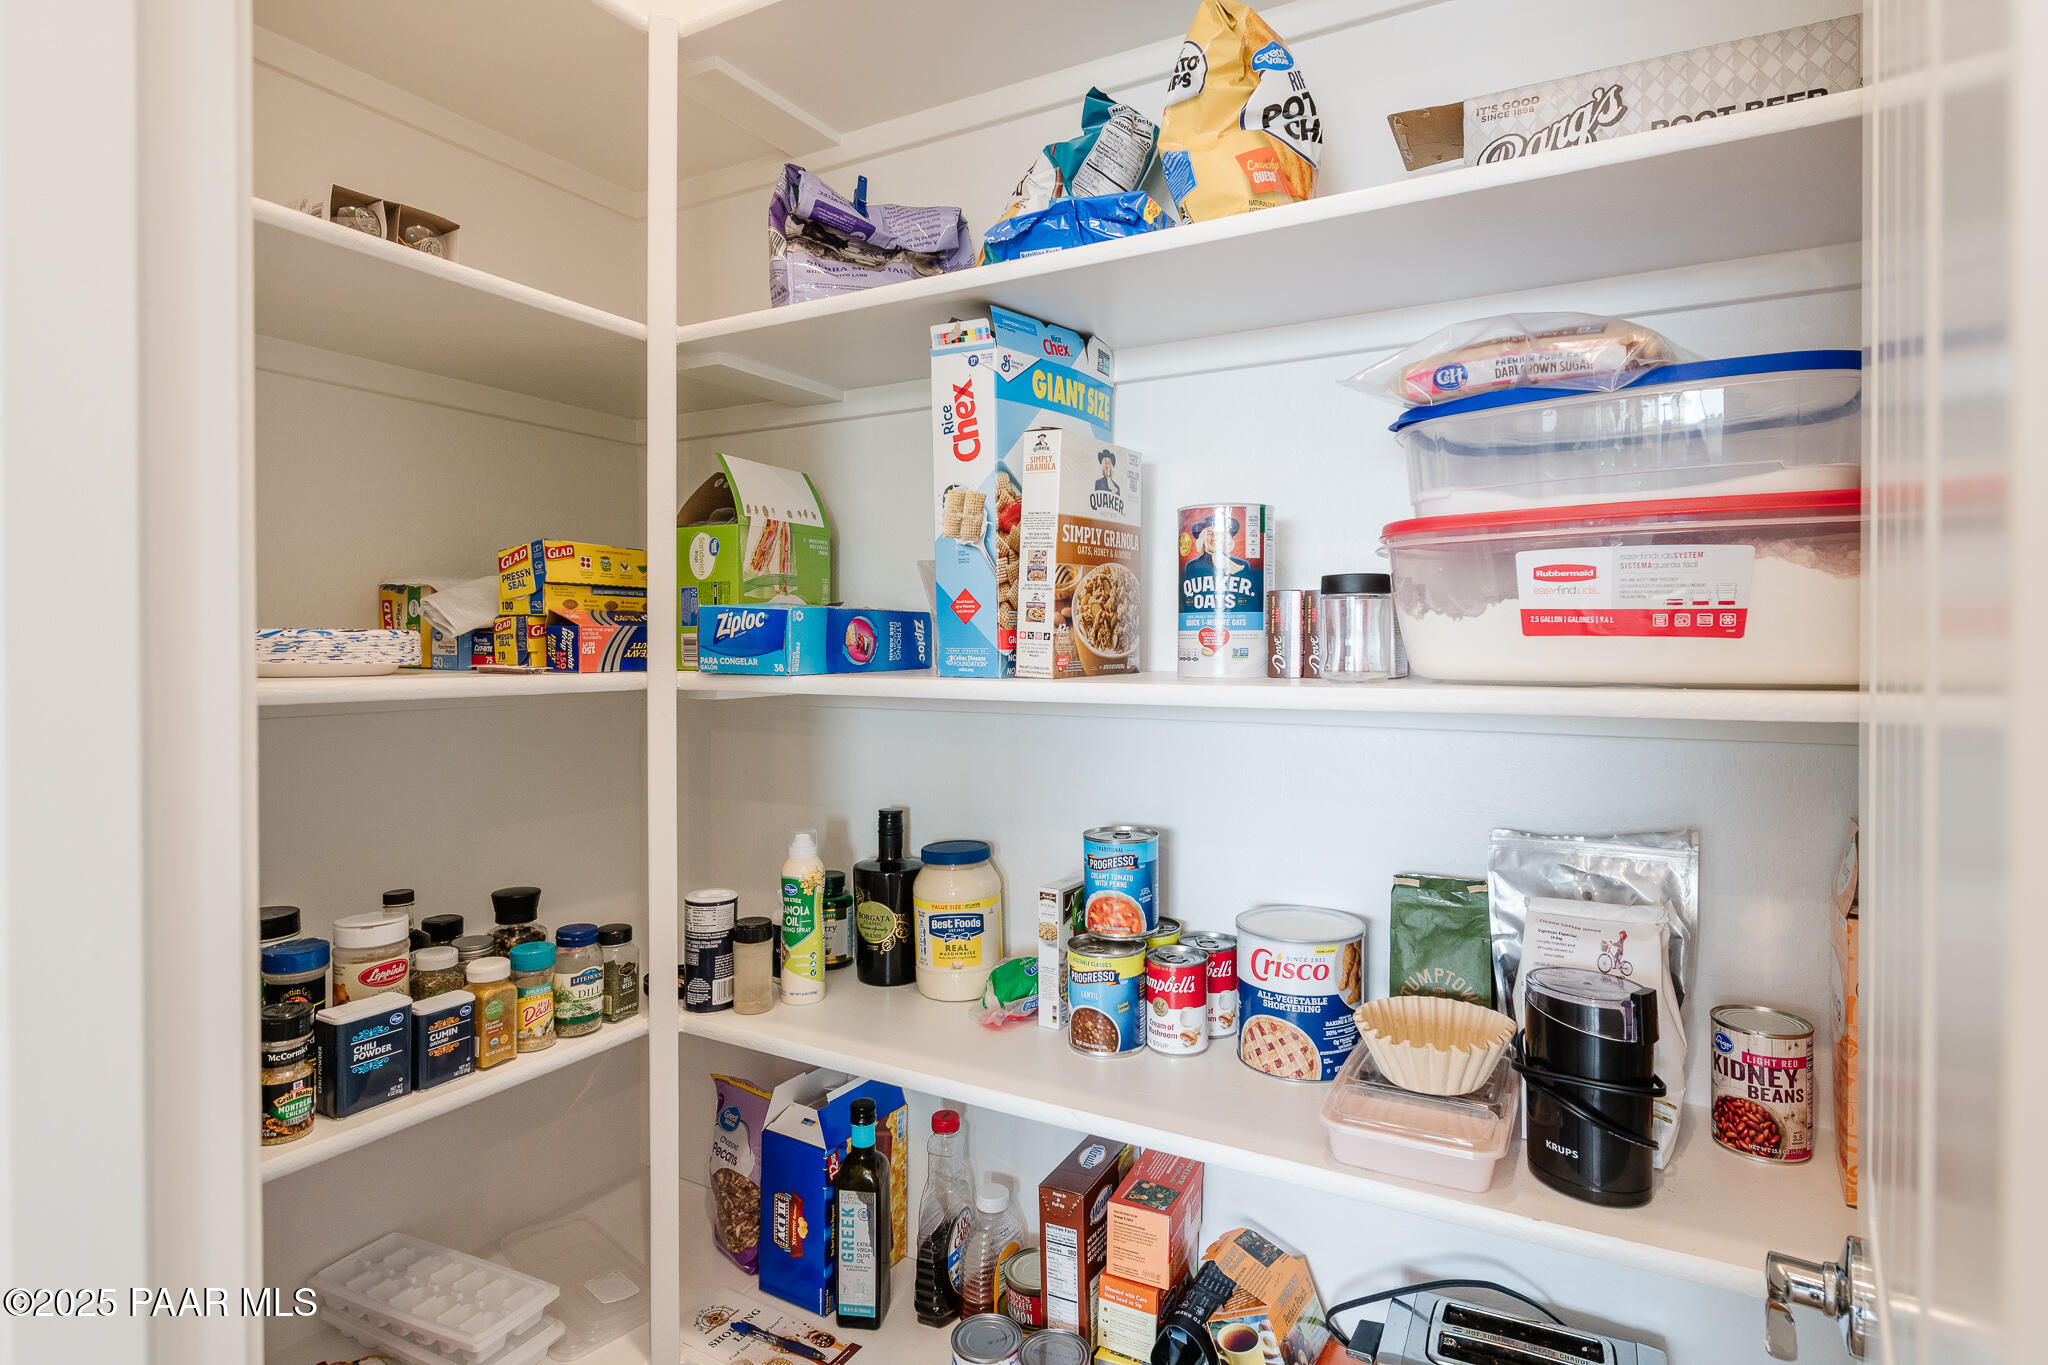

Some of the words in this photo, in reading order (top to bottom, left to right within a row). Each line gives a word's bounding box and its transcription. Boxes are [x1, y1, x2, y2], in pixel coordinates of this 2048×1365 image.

[1254, 47, 1286, 64] Great
[1266, 54, 1290, 66] Value
[1476, 104, 1498, 117] IT'S
[1502, 96, 1540, 110] GOOD
[1481, 110, 1510, 123] SINCE
[1513, 106, 1535, 116] 1898
[1247, 160, 1279, 171] Crunchy
[1252, 172, 1277, 183] QUESO
[1050, 334, 1063, 343] Rice
[1042, 338, 1070, 356] Chex
[1436, 367, 1464, 389] C&H
[1032, 369, 1086, 411] GIANT
[1087, 388, 1111, 422] SIZE
[941, 404, 955, 435] Rice
[952, 378, 981, 462] Chex
[1030, 455, 1053, 464] SIMPLY
[1025, 462, 1056, 472] GRANOLA
[1089, 494, 1124, 517] QUAKER
[1062, 523, 1103, 545] SIMPLY
[1103, 530, 1140, 551] GRANOLA
[547, 546, 574, 559] GLAD
[1077, 546, 1092, 557] OATS,
[1094, 547, 1109, 557] HONEY
[1673, 551, 1705, 559] SYSTEM
[501, 548, 527, 569] GLAD
[502, 568, 531, 583] PRESS'N
[1536, 569, 1594, 577] Rubbermaid
[507, 581, 527, 590] SEAL
[501, 601, 514, 610] 100
[1193, 594, 1236, 609] OATS
[495, 620, 511, 632] GLAD
[716, 609, 768, 639] Ziploc
[1232, 618, 1247, 626] OATS
[1567, 616, 1594, 624] GALONES
[496, 633, 514, 641] PRESS'N
[913, 619, 926, 662] Ziploc
[566, 628, 574, 670] Reynolds
[581, 647, 596, 655] 150
[1271, 635, 1286, 674] Dove
[433, 657, 444, 667] 50
[486, 656, 493, 664] 75
[498, 652, 506, 660] 70
[701, 657, 719, 666] PARA
[720, 657, 759, 666] CONGELAR
[774, 664, 784, 673] 38
[1089, 856, 1135, 870] PROGRESSO
[1091, 872, 1110, 881] CREAMY
[1110, 873, 1133, 882] TOMATO
[1095, 879, 1108, 887] WITH
[1109, 880, 1128, 888] PENNE
[786, 916, 799, 927] OIL
[859, 912, 890, 922] BORGATA
[932, 919, 953, 929] Best
[954, 918, 981, 929] Foods
[945, 944, 969, 952] REAL
[1251, 948, 1330, 982] Crisco
[1286, 955, 1308, 963] SINCE
[1071, 969, 1115, 984] PROGRESSO
[578, 986, 602, 998] DILL
[622, 982, 633, 990] WEED
[1080, 991, 1099, 1000] LENTIL
[1257, 989, 1328, 1005] ALL-VEGETABLE
[523, 1001, 552, 1022] Dash
[1262, 1000, 1321, 1014] SHORTENING
[1150, 1018, 1167, 1030] Cream
[1325, 1019, 1344, 1027] BAKING
[430, 1027, 458, 1041] CUMIN
[353, 1041, 377, 1054] CHILI
[430, 1037, 449, 1047] GROUND
[1152, 1039, 1169, 1048] SOUP
[1715, 1035, 1732, 1051] Kroger
[353, 1043, 392, 1062] POWDER
[1746, 1055, 1777, 1067] LIGHT
[1781, 1059, 1798, 1068] RED
[1713, 1050, 1799, 1089] KIDNEY
[278, 1094, 294, 1106] Grill
[1748, 1085, 1804, 1104] BEANS
[278, 1098, 312, 1114] MONTREAL
[286, 1107, 309, 1118] CHICKEN
[724, 1111, 739, 1120] Great
[720, 1135, 739, 1151] Chopped
[1792, 1134, 1803, 1142] 3.5
[1546, 1139, 1579, 1160] KRUPS
[1748, 1143, 1760, 1151] NET
[712, 1141, 738, 1167] Pecans
[1083, 1144, 1106, 1170] Minute
[829, 1160, 840, 1181] 12
[777, 1216, 787, 1241] ACT
[841, 1207, 855, 1263] GREEK
[1104, 1285, 1123, 1297] Blended
[1124, 1290, 1135, 1299] with
[1135, 1293, 1148, 1303] Care
[1104, 1292, 1115, 1300] from
[1116, 1295, 1127, 1304] Seed
[1134, 1300, 1143, 1309] Sip
[1283, 1305, 1297, 1327] Perfect
[709, 1308, 761, 1348] SHOING
[1465, 1328, 1480, 1336] HOT
